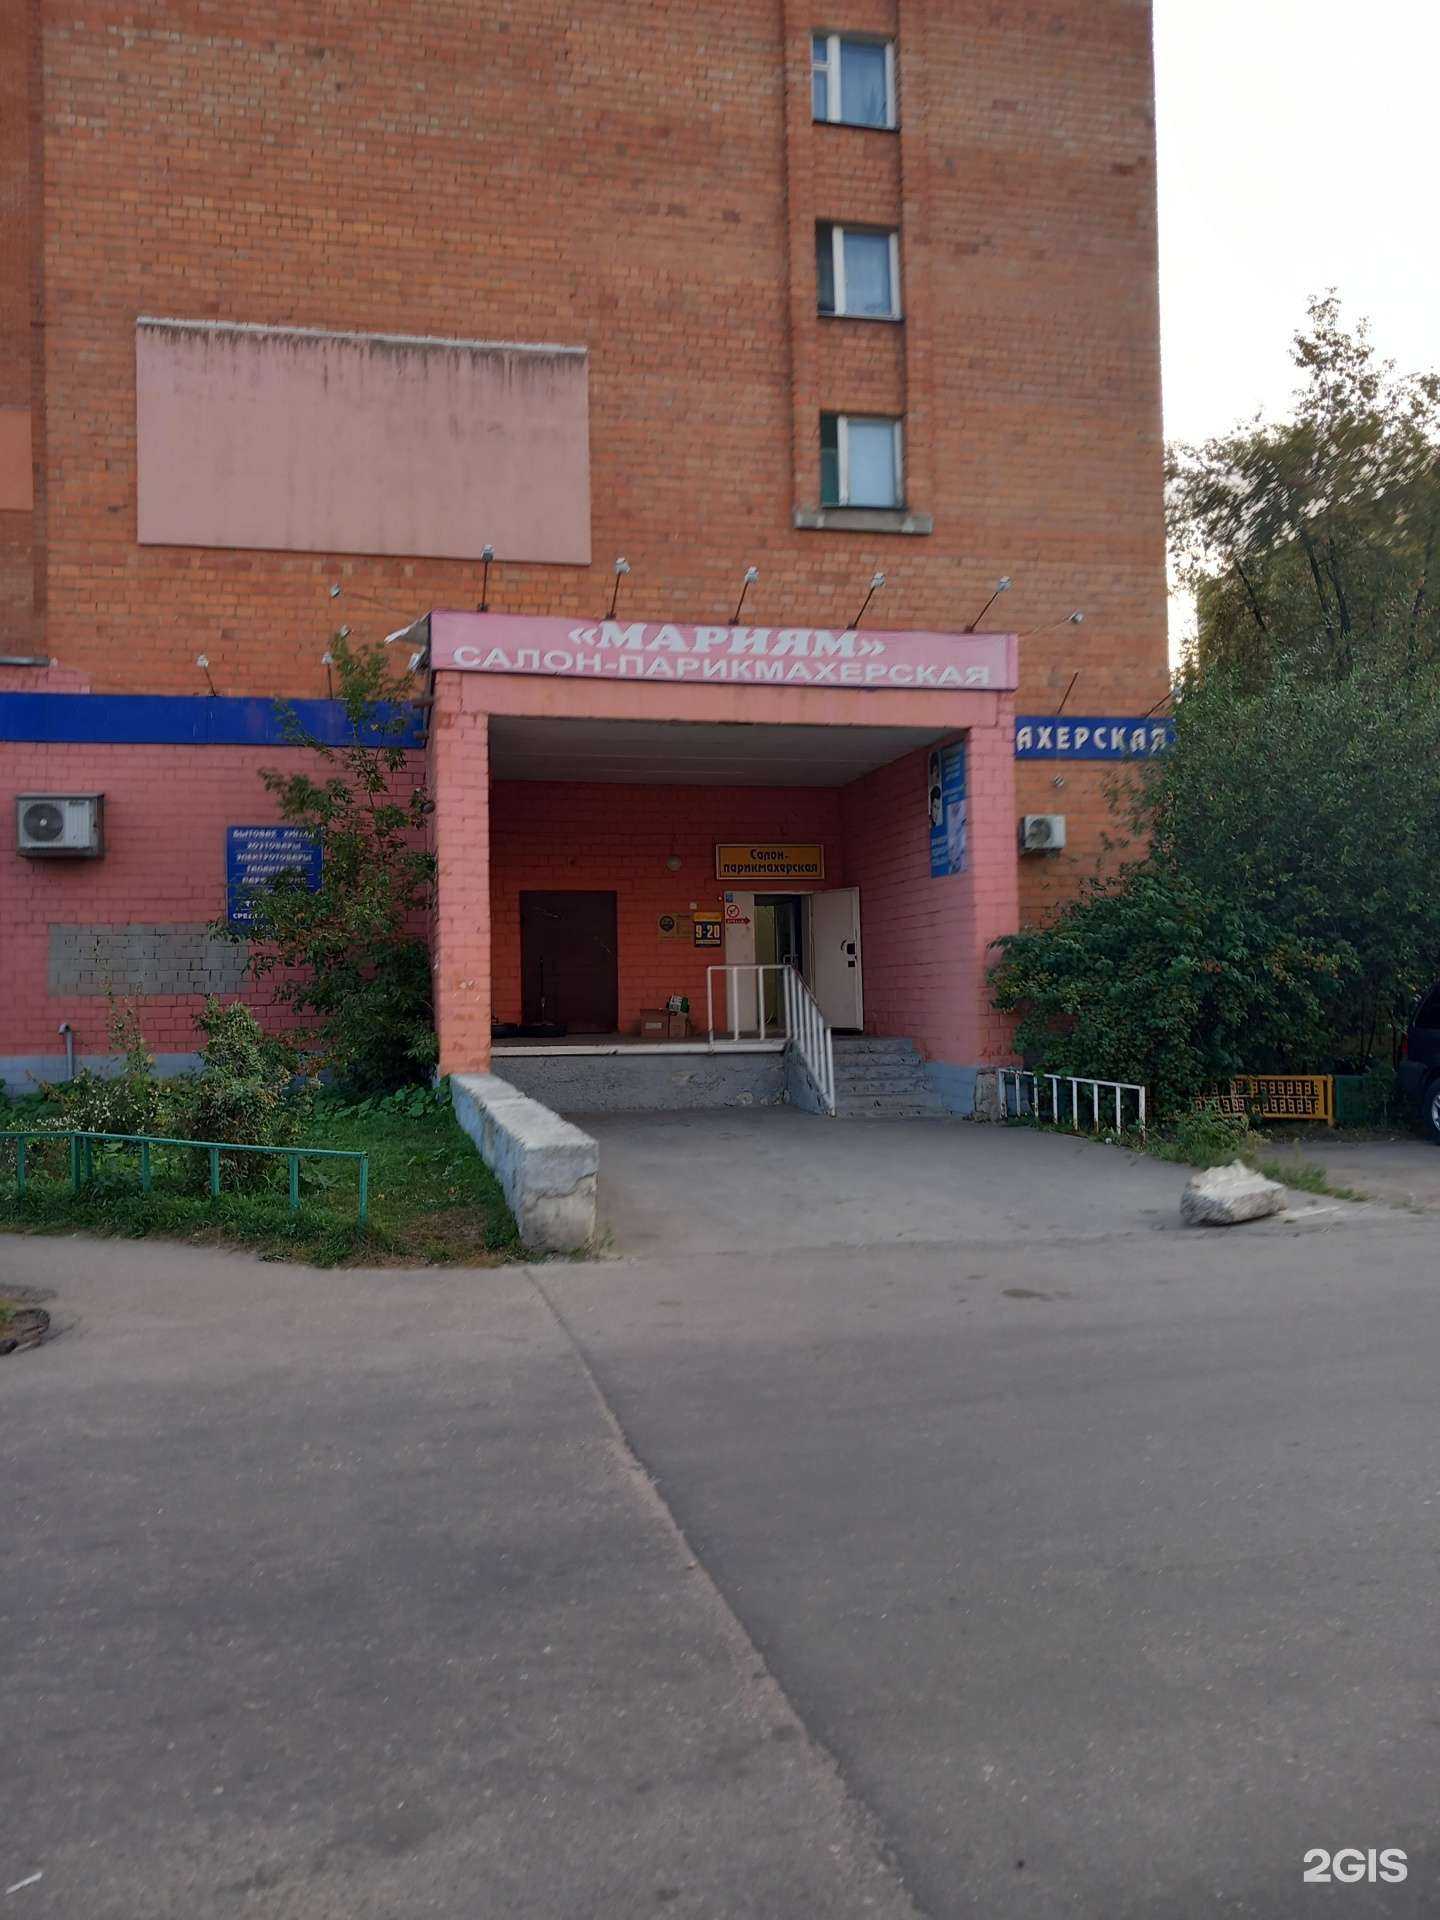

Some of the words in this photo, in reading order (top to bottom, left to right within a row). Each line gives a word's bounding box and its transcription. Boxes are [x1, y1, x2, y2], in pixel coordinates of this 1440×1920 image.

[568, 621, 887, 657] «МАРИЯМ»
[453, 644, 991, 686] САЛОН-ПАРИКМАХЕРСКАЯ
[723, 863, 818, 875] парикмахерская
